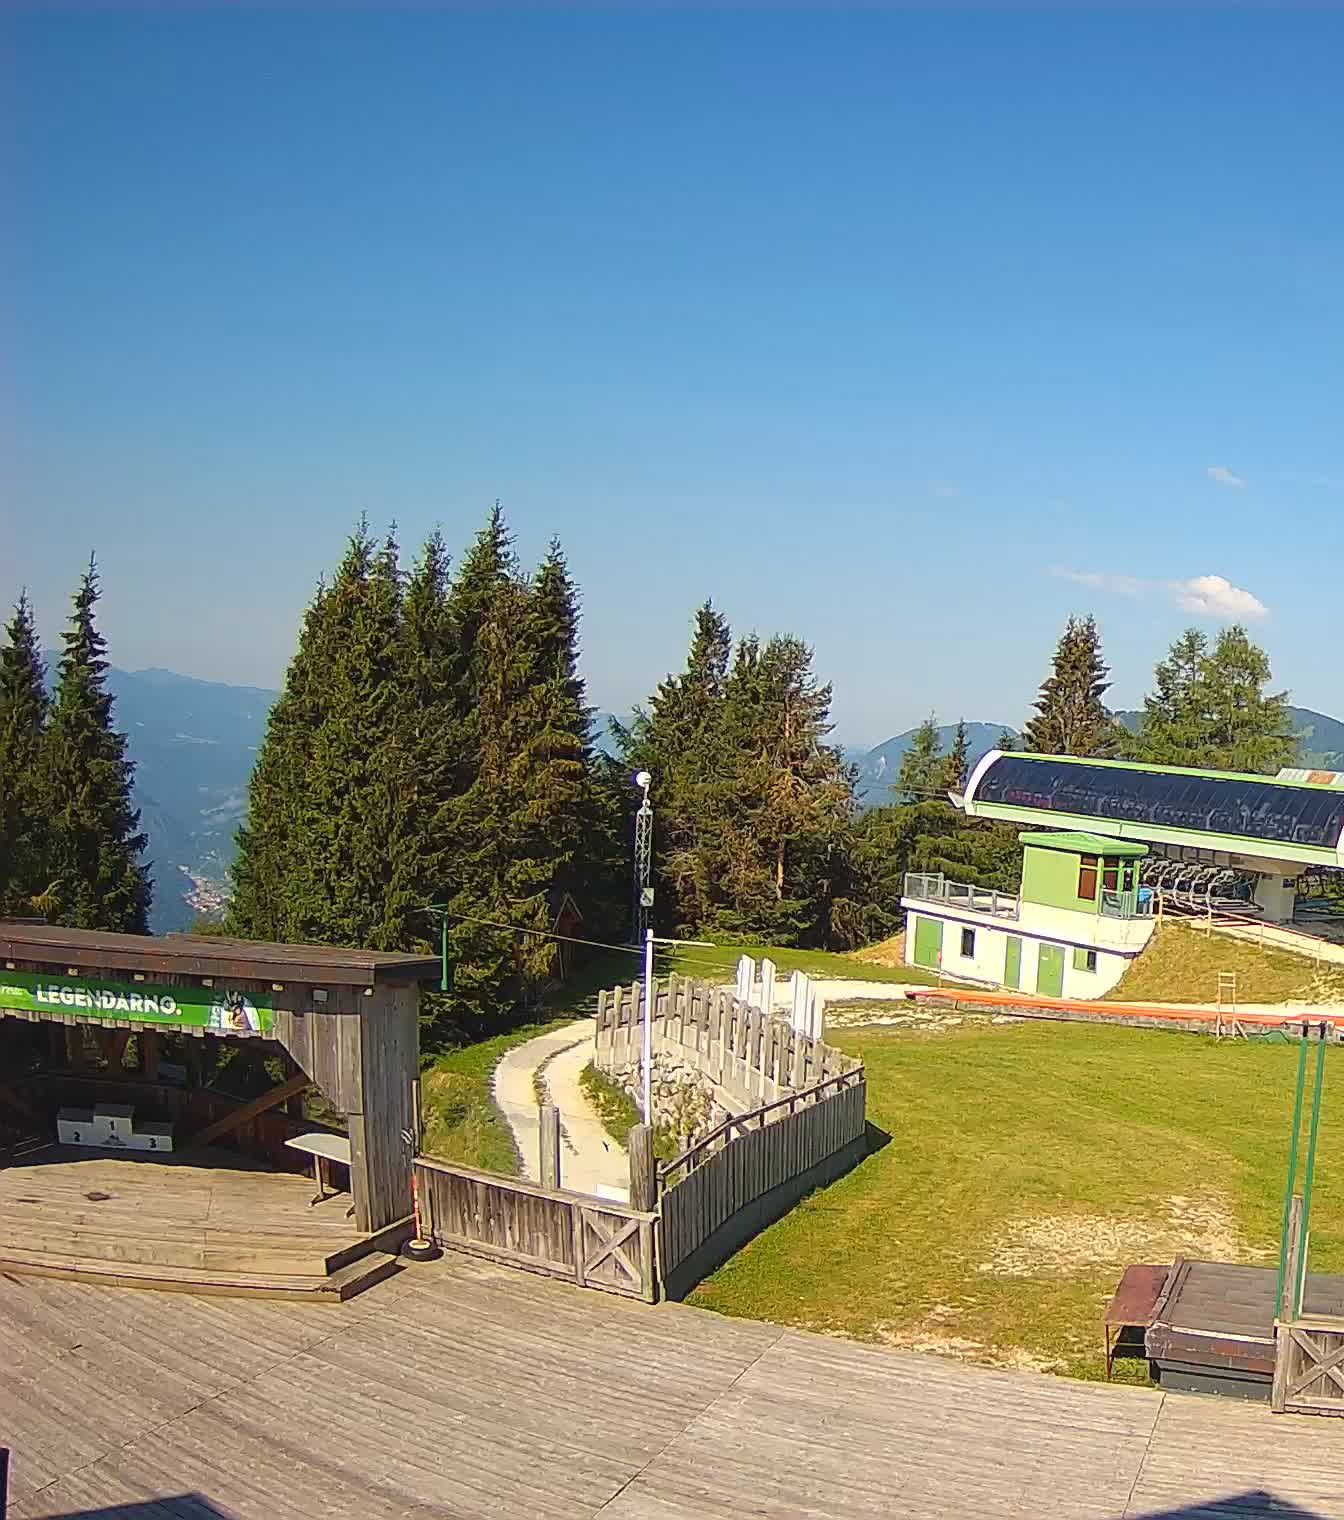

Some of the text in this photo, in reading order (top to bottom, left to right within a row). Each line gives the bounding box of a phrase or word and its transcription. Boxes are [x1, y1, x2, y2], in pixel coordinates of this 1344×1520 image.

[36, 984, 183, 1016] LEGENDARNO.
[73, 1131, 81, 1142] 2
[149, 1137, 157, 1148] 3
